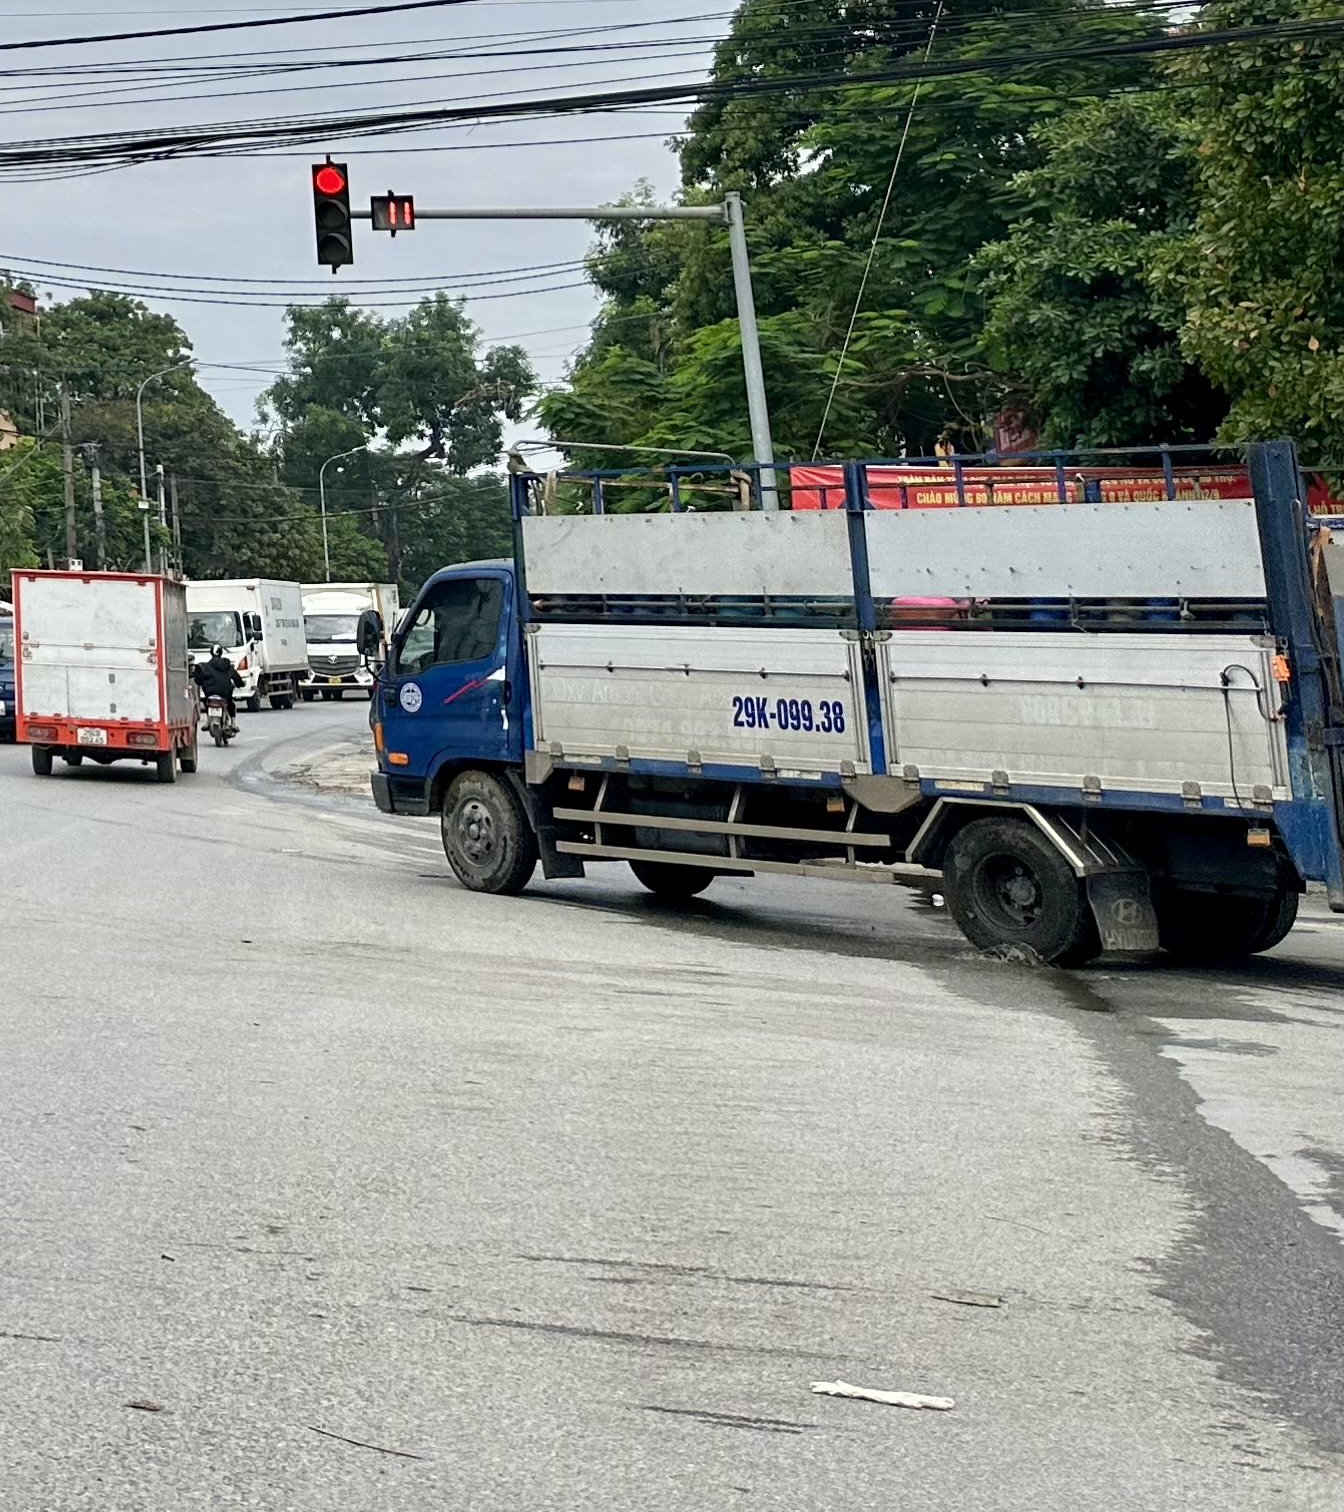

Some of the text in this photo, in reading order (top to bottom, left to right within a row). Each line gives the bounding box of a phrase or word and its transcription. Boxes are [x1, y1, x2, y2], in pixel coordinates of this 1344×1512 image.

[389, 201, 411, 225] 11
[917, 490, 942, 504] CHÀO
[944, 489, 973, 504] MỪG
[733, 696, 845, 734] 29K-099.38
